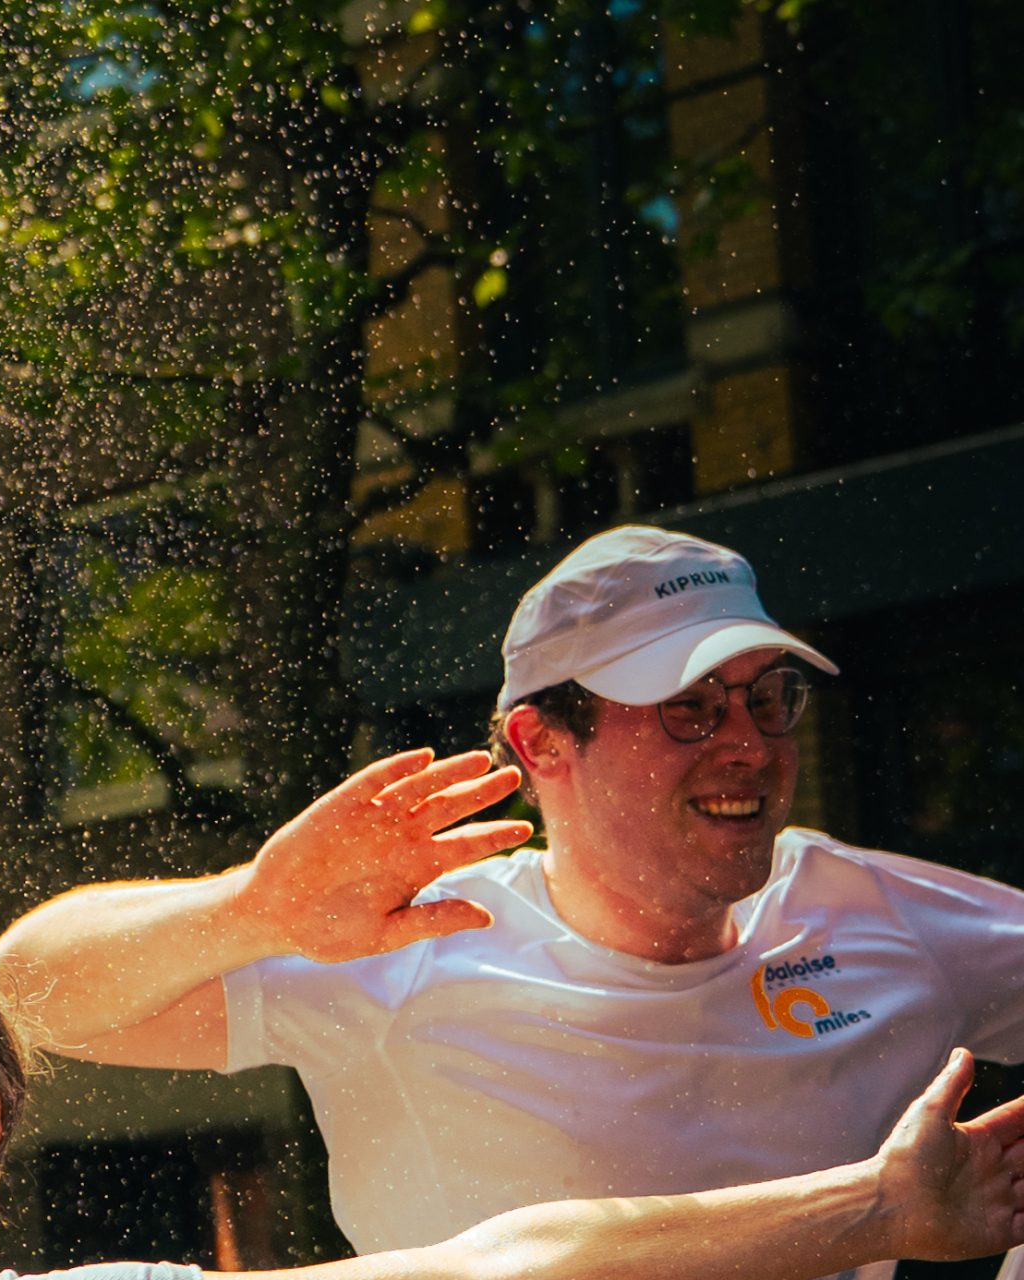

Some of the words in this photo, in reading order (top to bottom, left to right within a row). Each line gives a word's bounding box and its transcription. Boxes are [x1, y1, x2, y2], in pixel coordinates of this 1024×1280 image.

[654, 570, 731, 599] KIPRUN
[765, 955, 835, 982] baloise
[815, 1010, 872, 1034] miles
